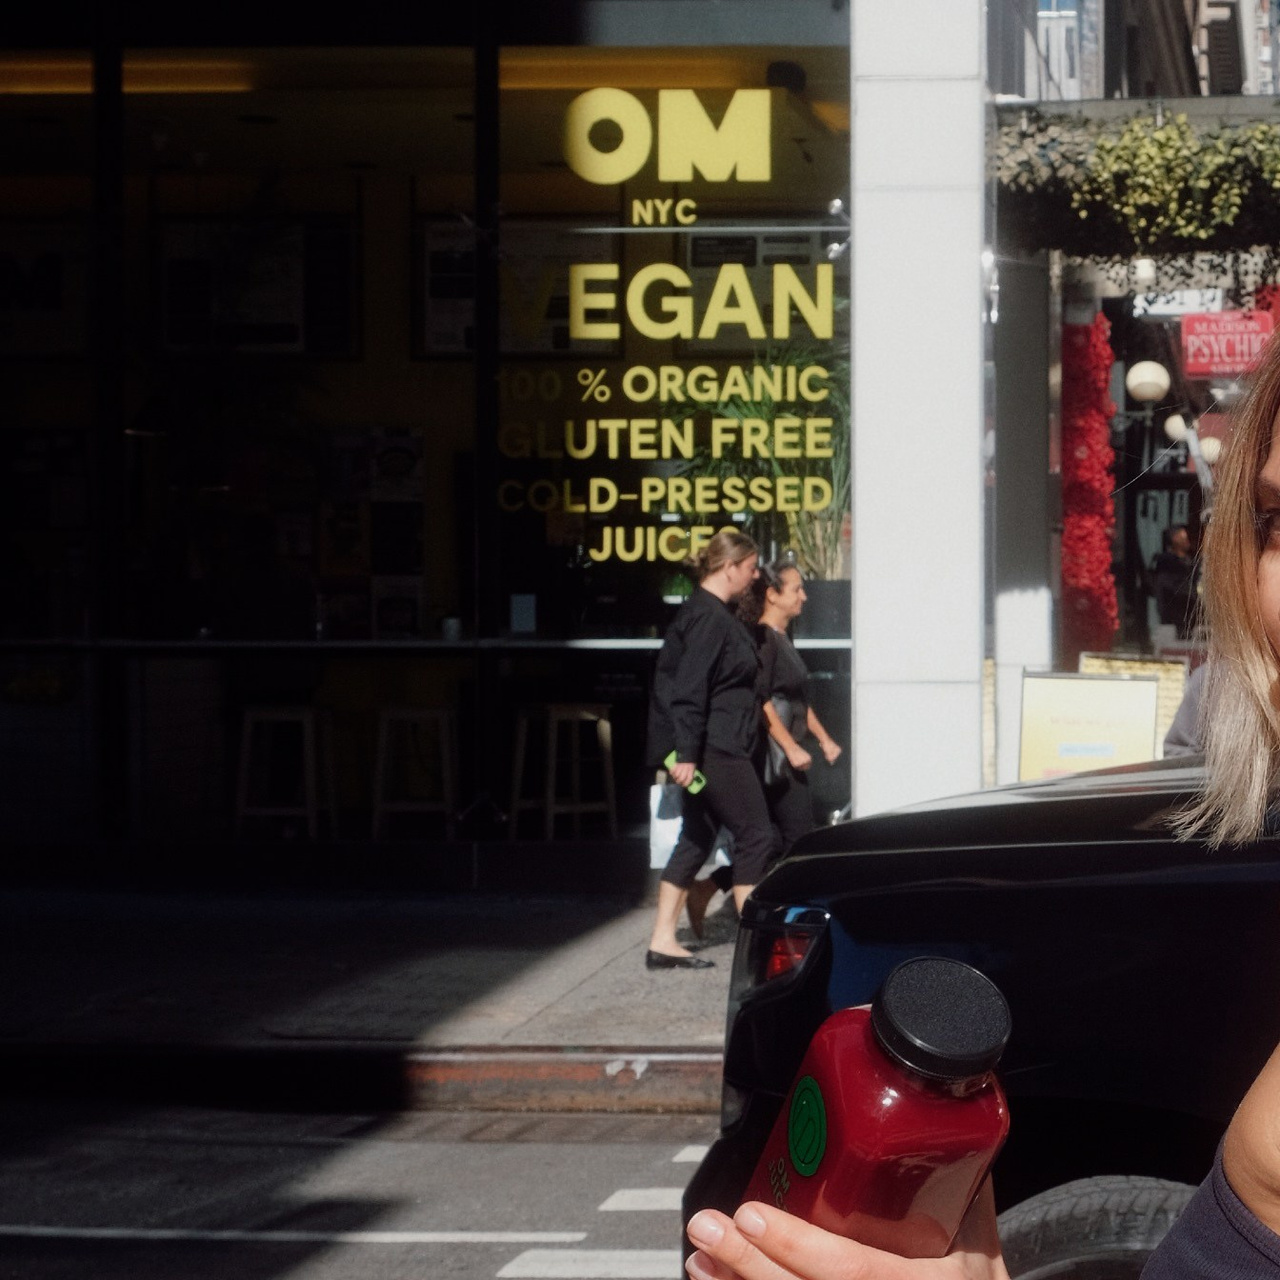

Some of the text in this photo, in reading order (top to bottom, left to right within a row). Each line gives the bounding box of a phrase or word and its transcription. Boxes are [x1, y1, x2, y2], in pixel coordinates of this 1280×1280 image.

[565, 86, 772, 185] OM
[631, 198, 698, 225] NYC
[621, 365, 830, 403] ORGANIC
[711, 418, 835, 460] FREE
[588, 525, 741, 563] JUICE
